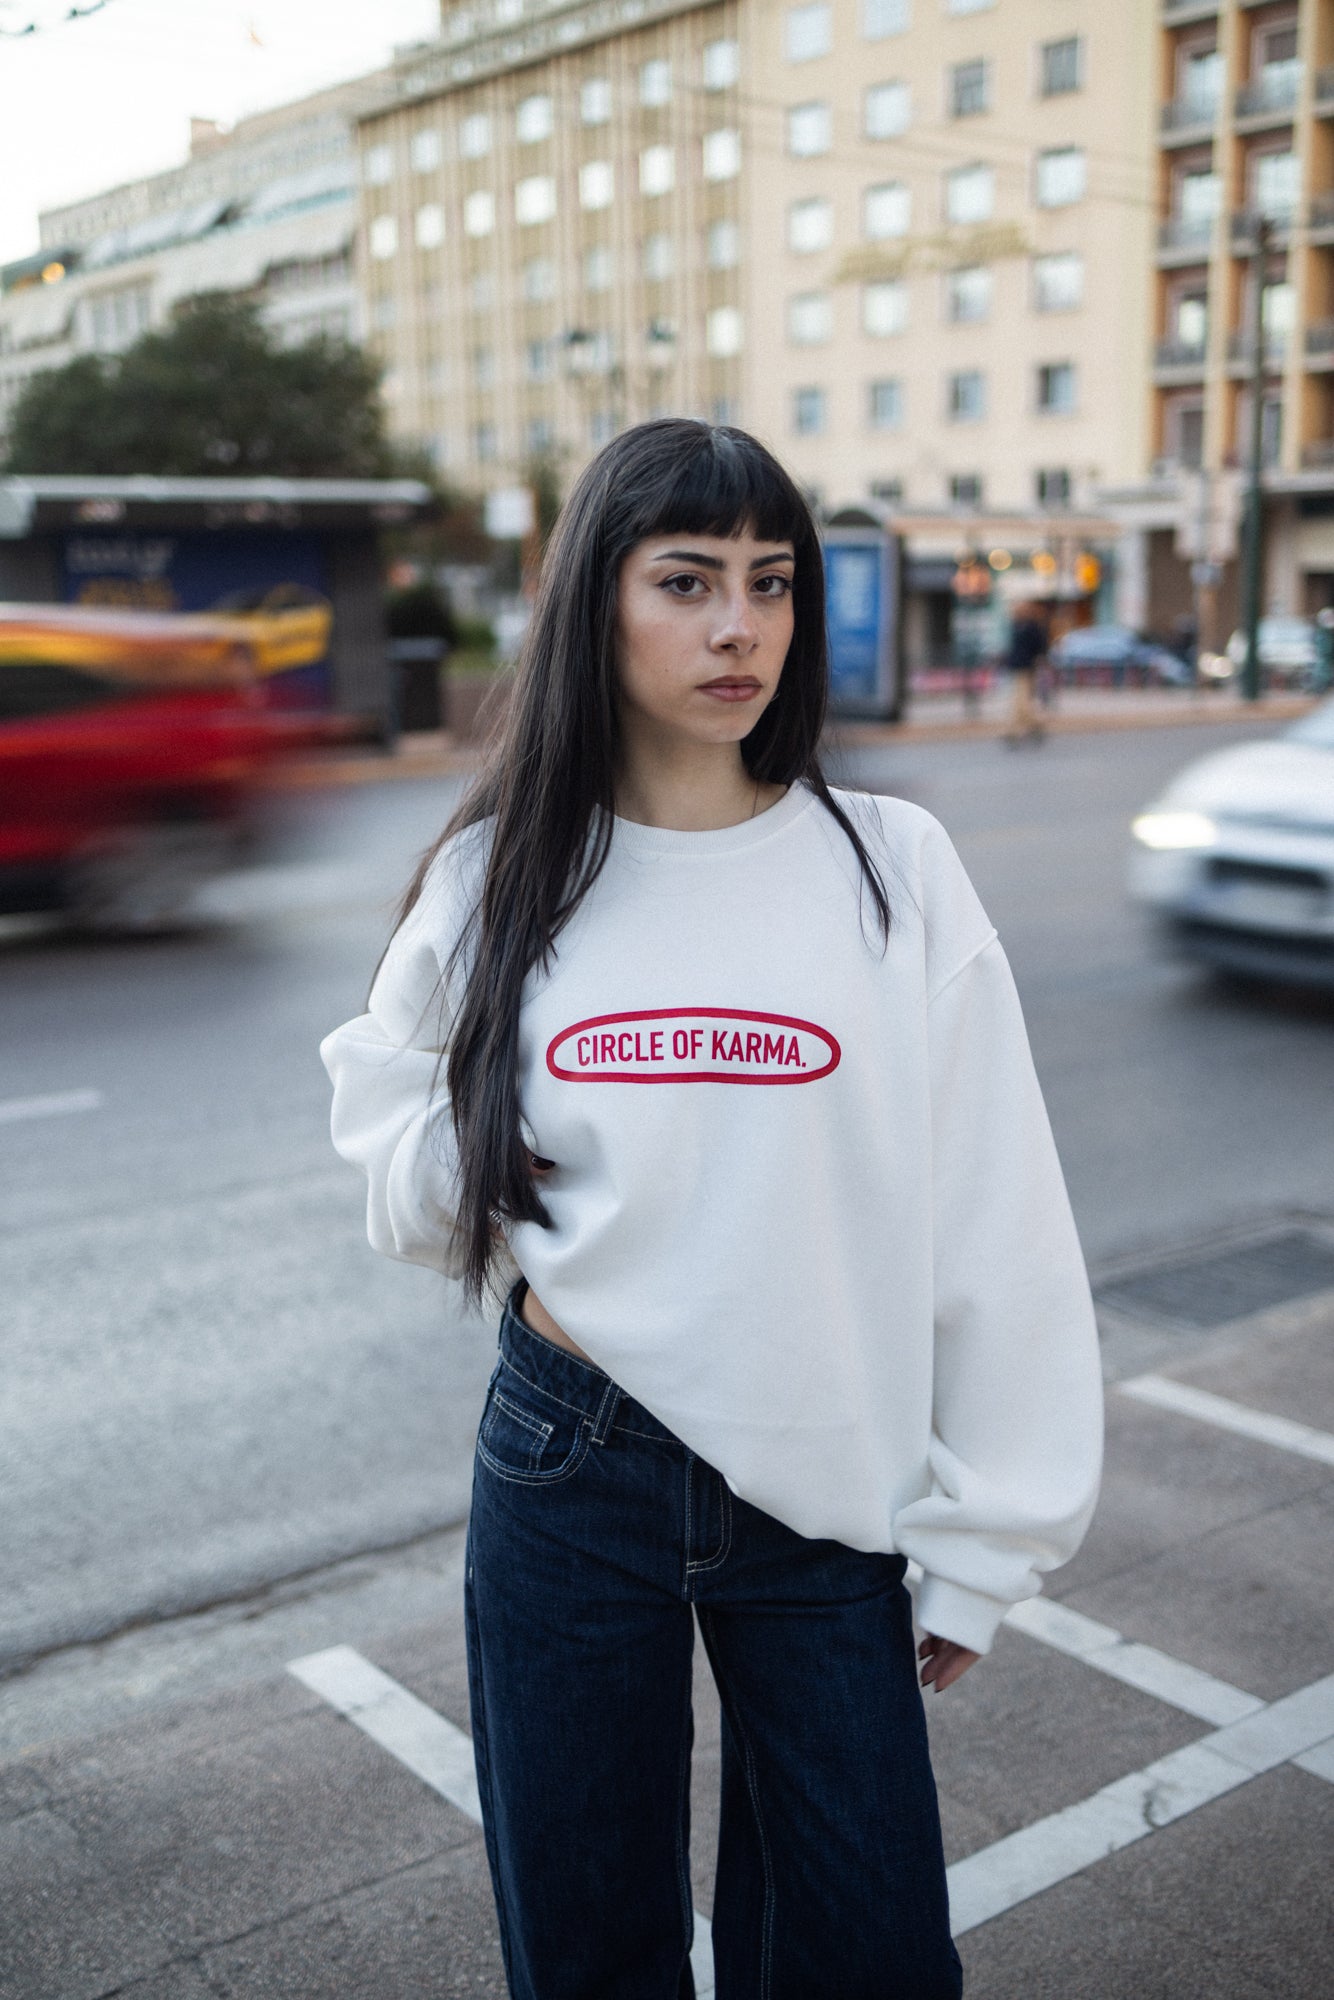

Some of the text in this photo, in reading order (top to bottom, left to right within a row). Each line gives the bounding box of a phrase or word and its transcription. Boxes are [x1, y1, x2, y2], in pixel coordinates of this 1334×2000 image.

[577, 1029, 807, 1068] CIRCLE OF KARMA.
